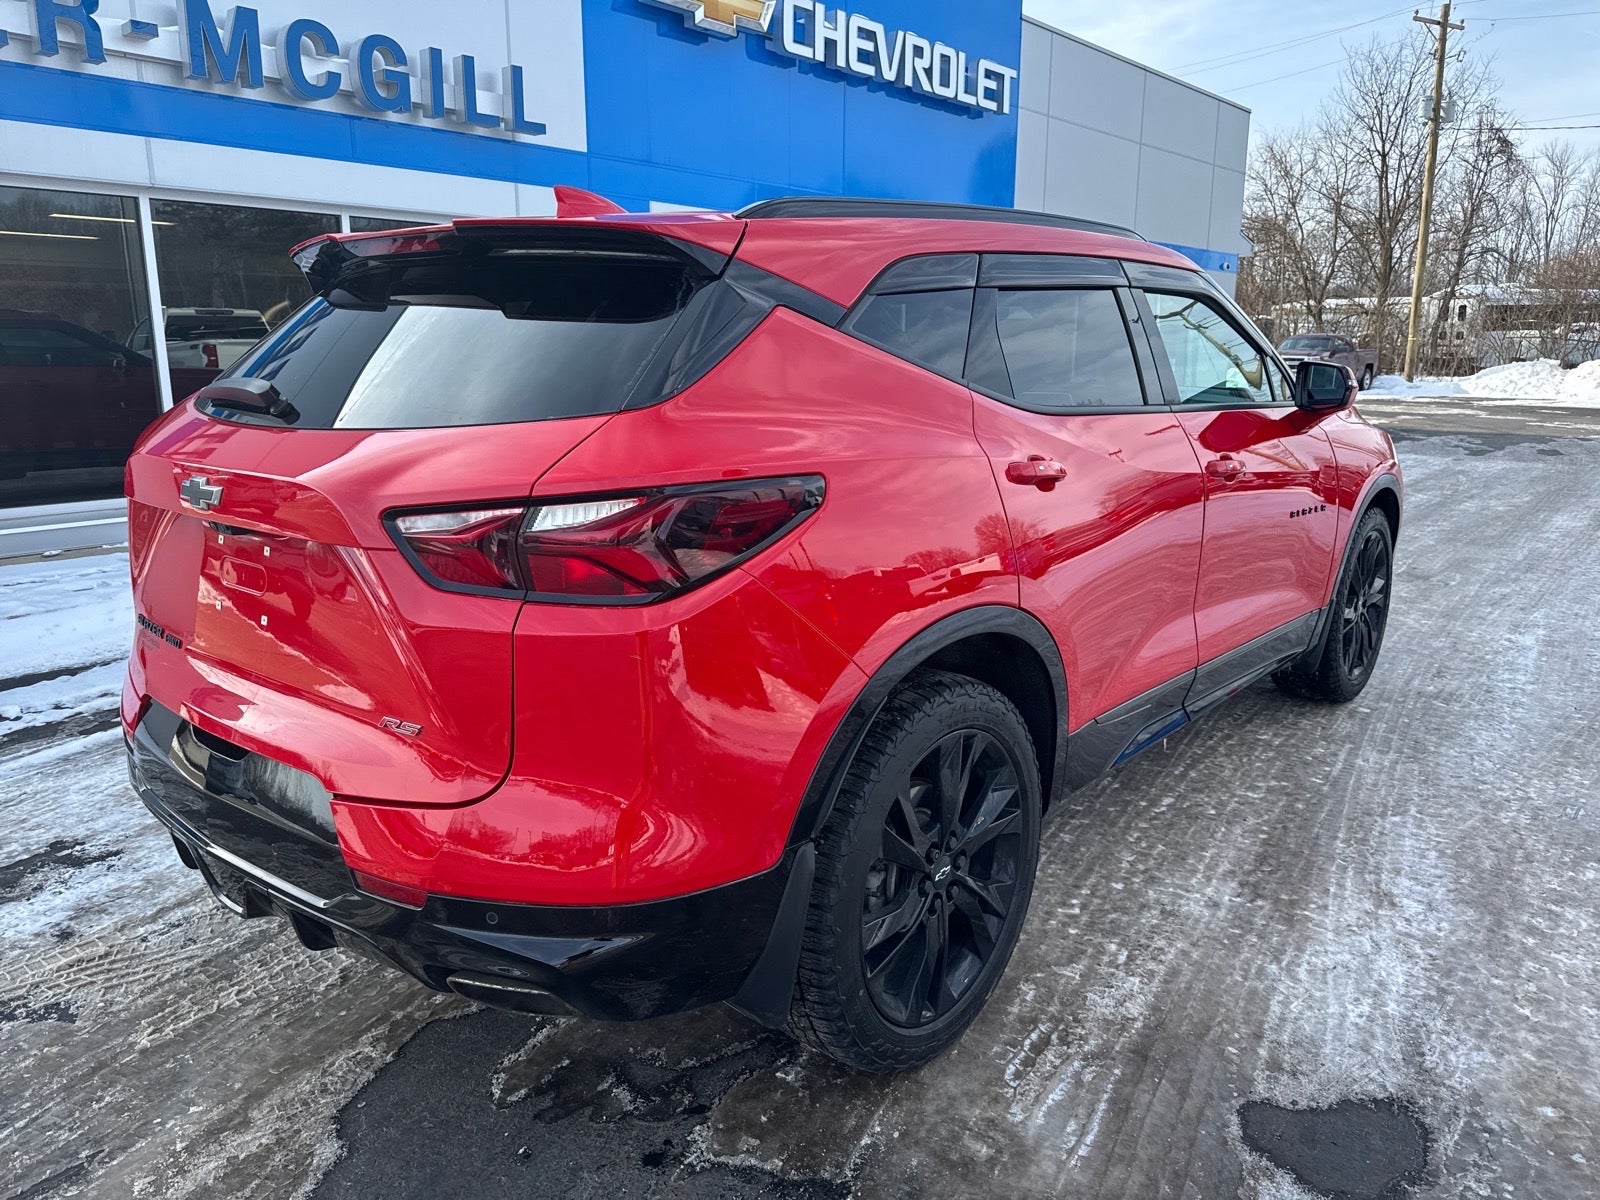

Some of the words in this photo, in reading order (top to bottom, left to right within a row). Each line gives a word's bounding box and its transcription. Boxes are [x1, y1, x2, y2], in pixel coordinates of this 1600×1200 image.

[0, 0, 547, 136] R-MCGILL
[781, 0, 1017, 115] CHEVROLET
[378, 716, 423, 737] RS
